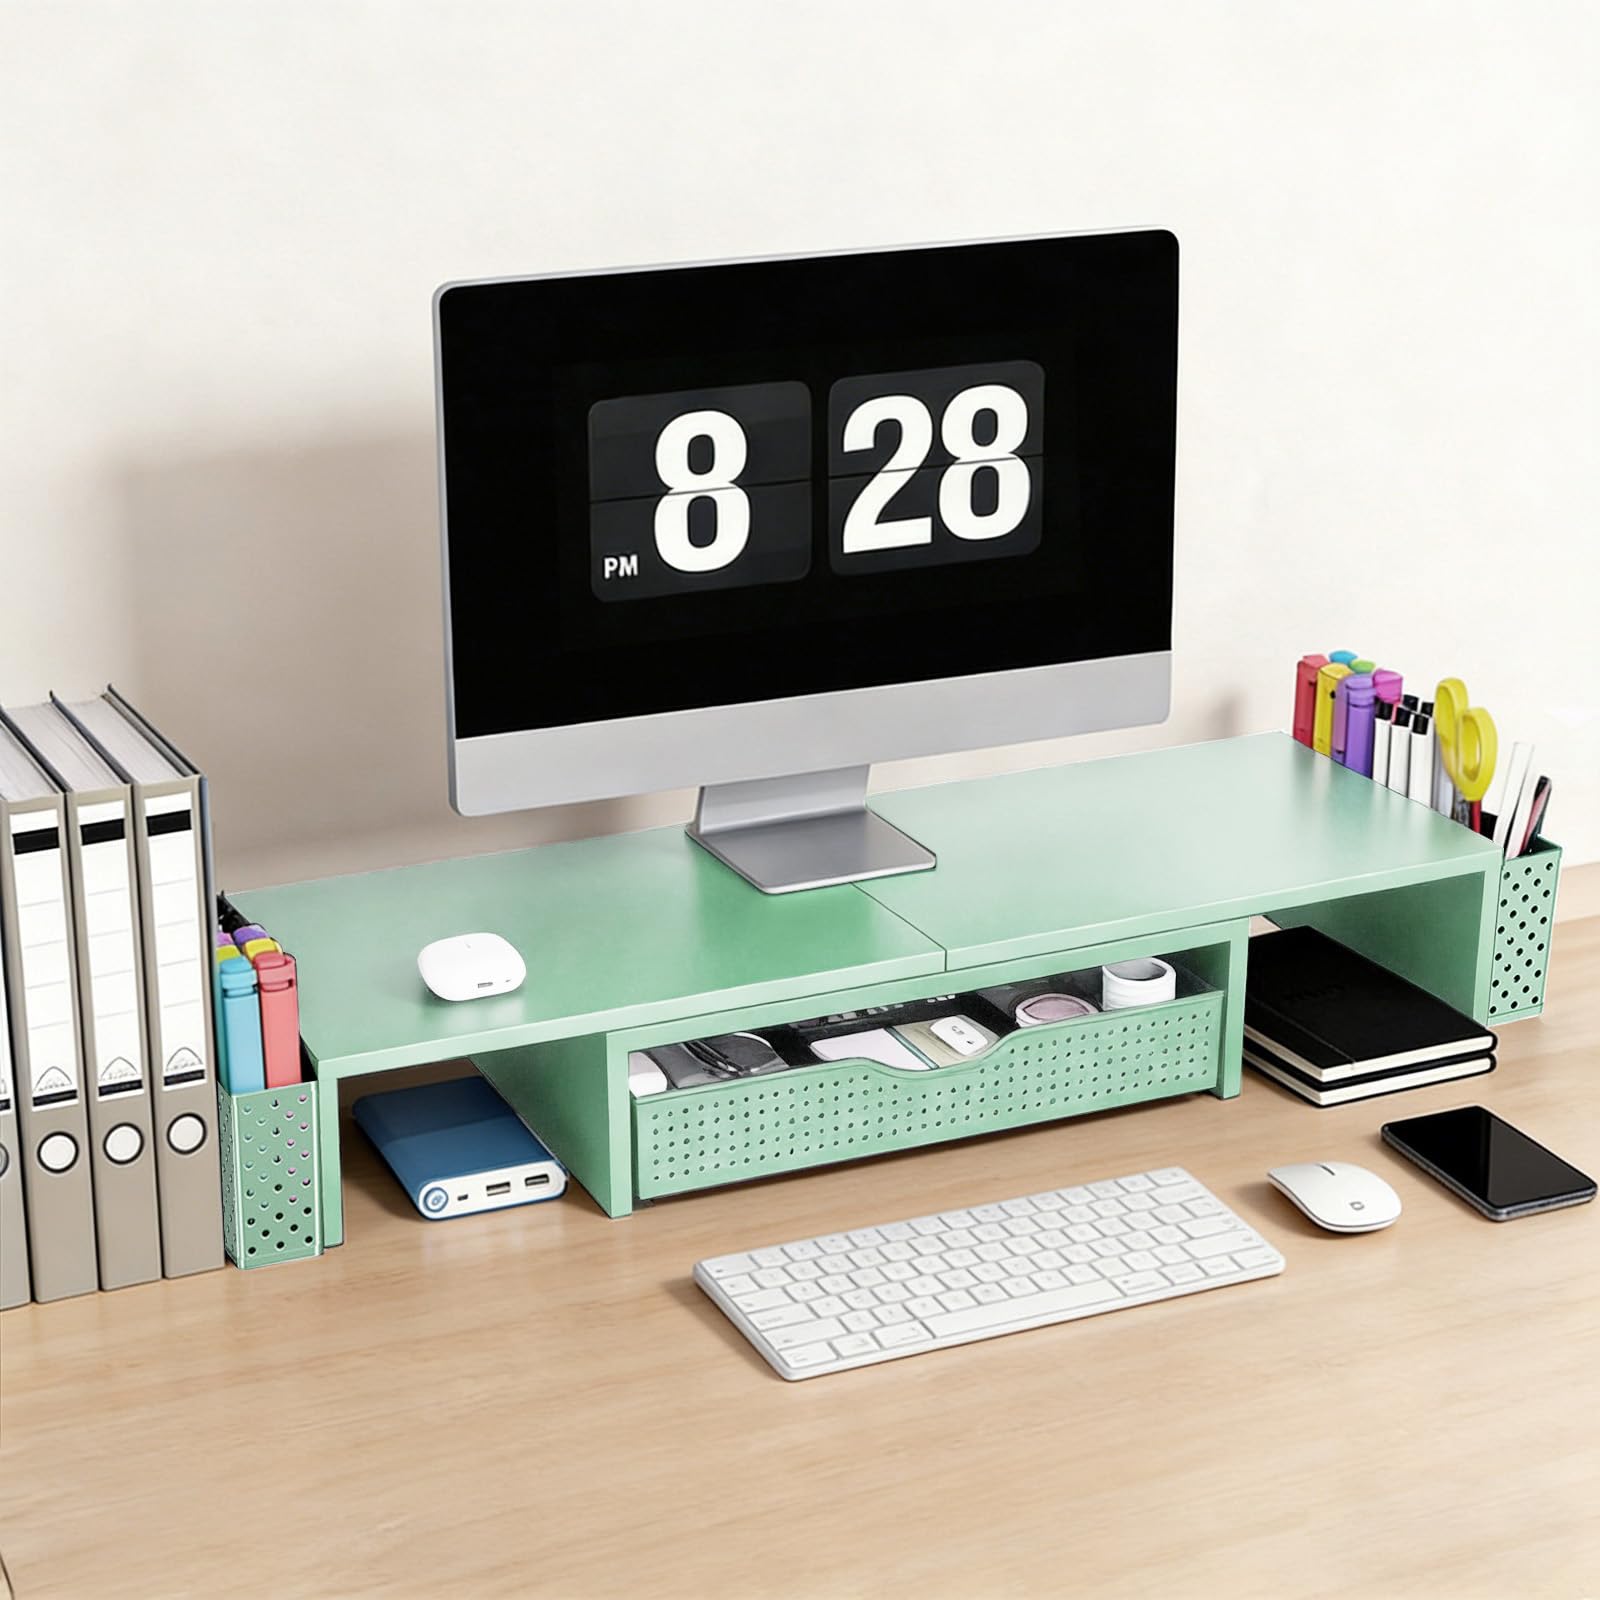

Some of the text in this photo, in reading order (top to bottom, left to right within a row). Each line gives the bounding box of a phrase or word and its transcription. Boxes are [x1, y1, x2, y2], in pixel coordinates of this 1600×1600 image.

[654, 384, 1031, 572] 8 28
[604, 554, 638, 579] PM
